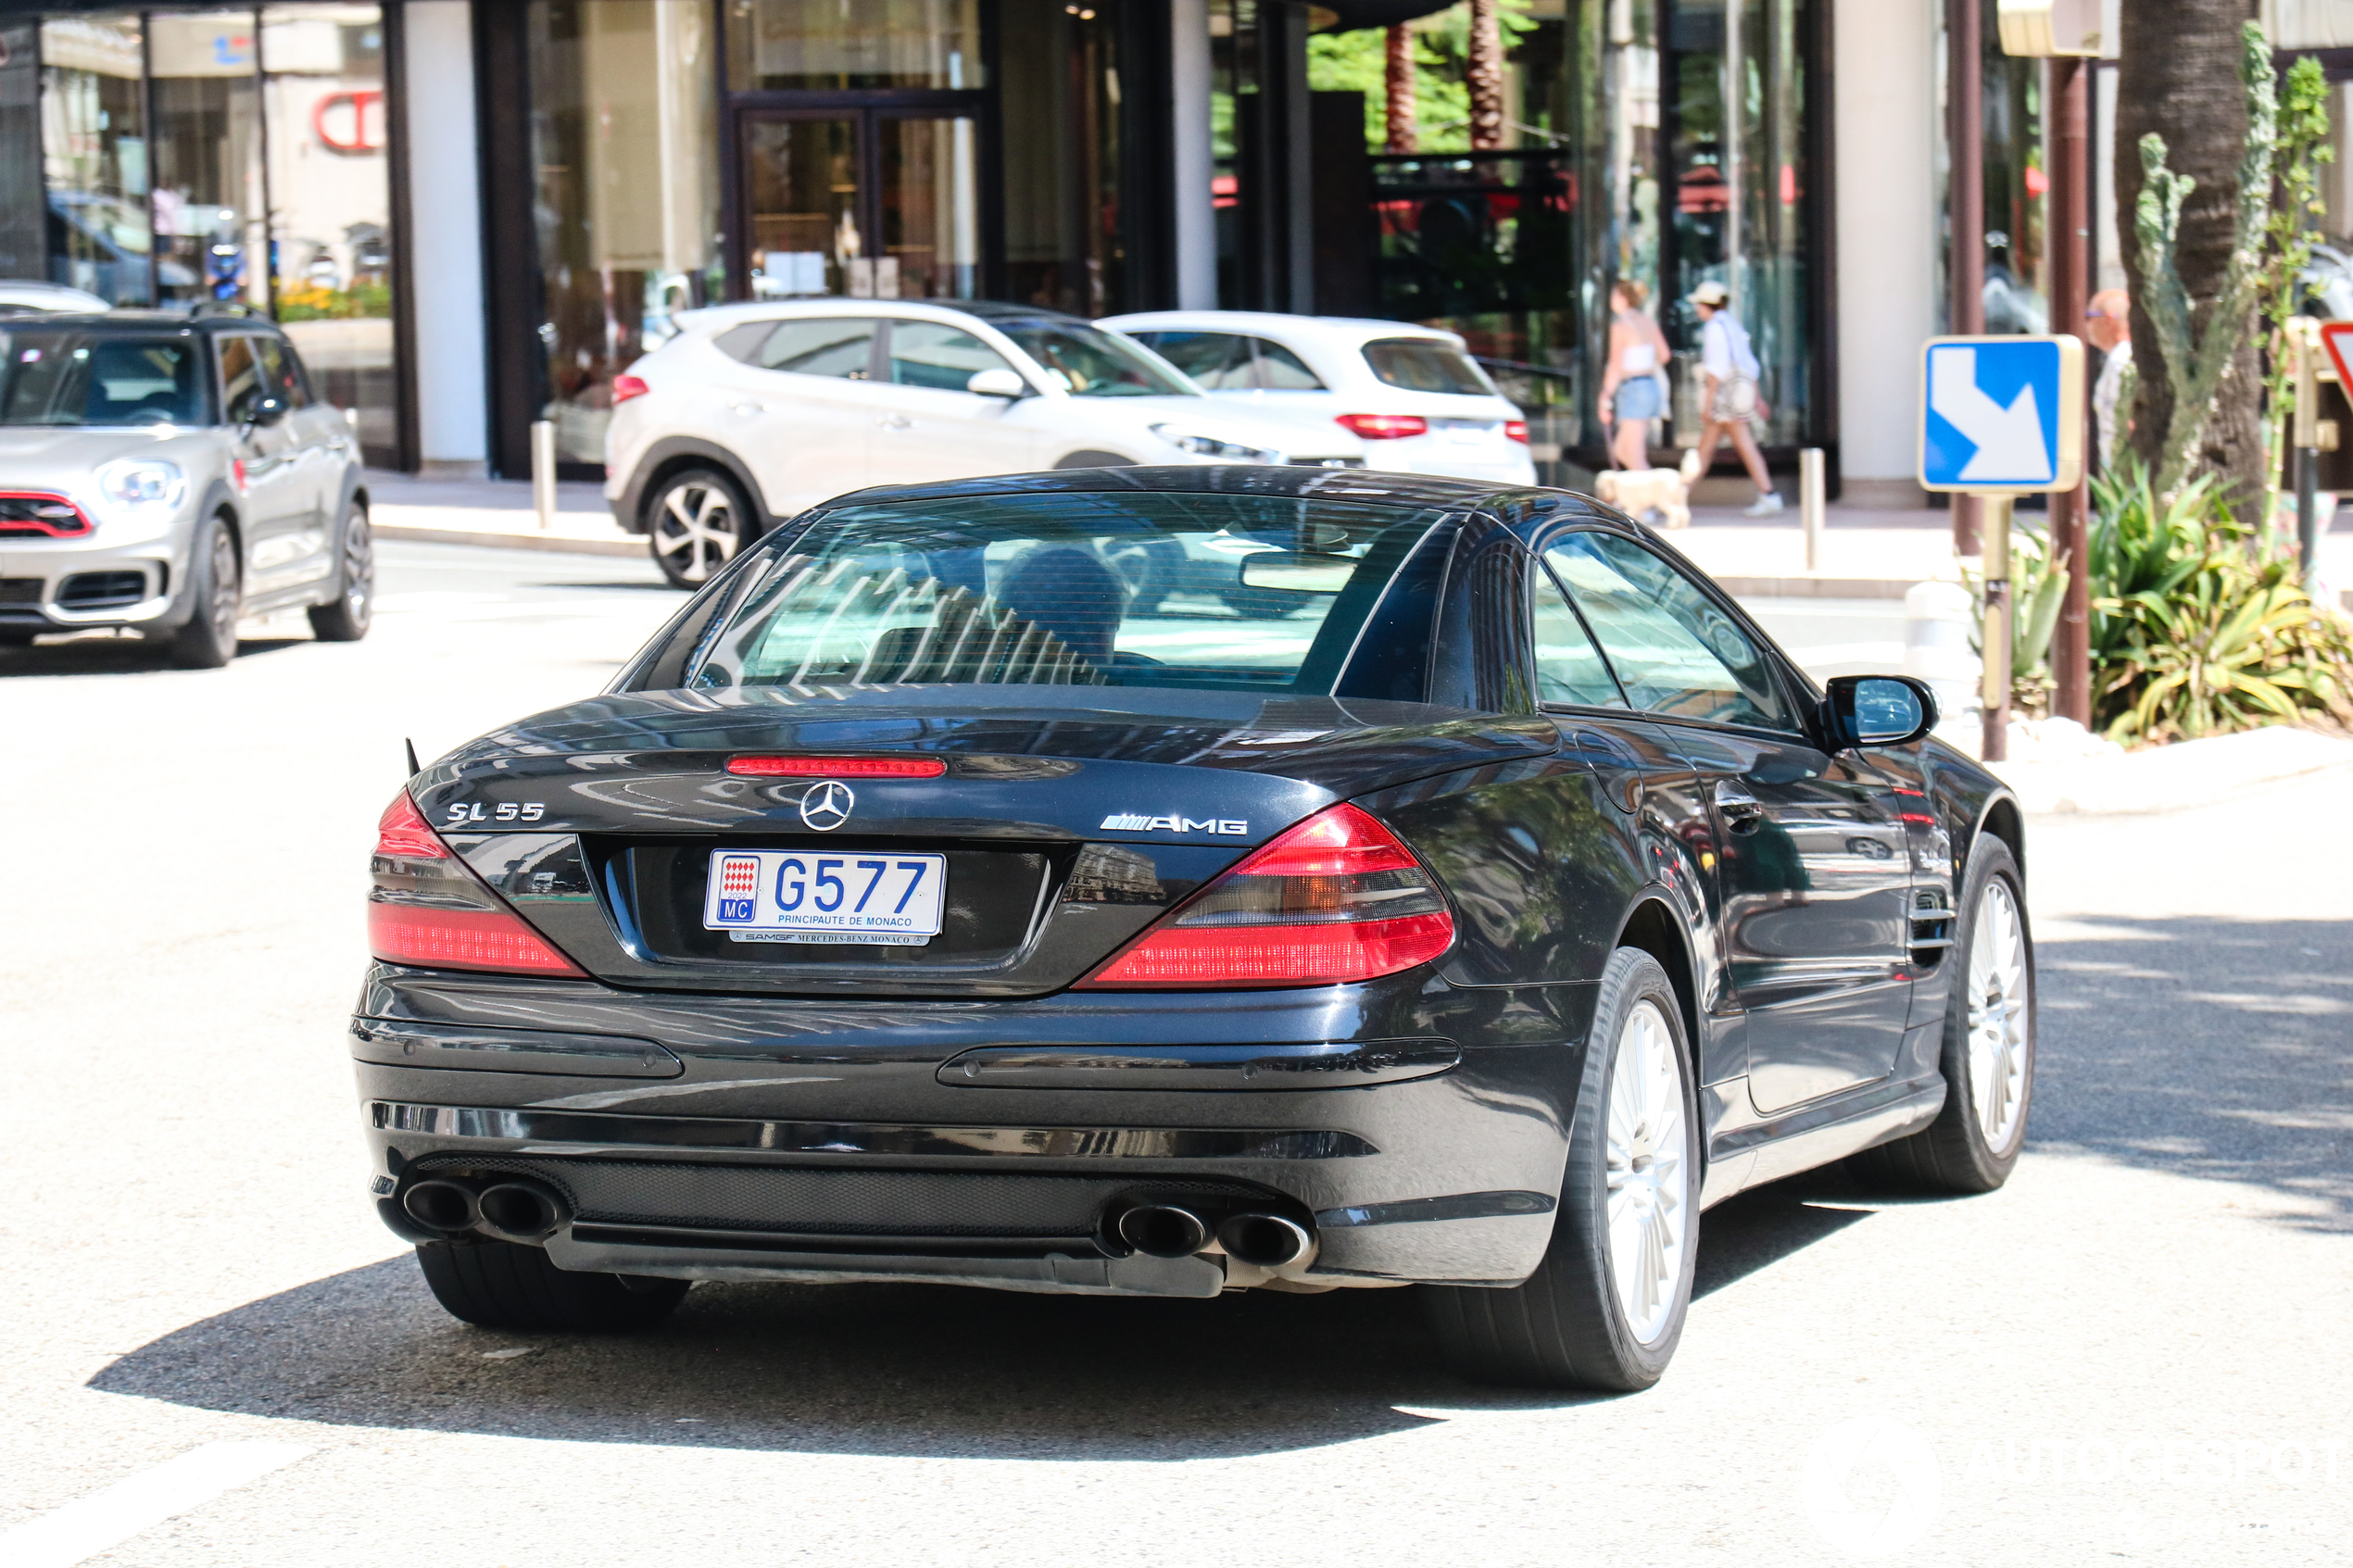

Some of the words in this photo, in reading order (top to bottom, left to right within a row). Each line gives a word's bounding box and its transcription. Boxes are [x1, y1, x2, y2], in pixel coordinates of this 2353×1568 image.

[447, 802, 487, 822] SL
[495, 802, 545, 822] 55
[1145, 815, 1248, 835] AMG
[774, 858, 927, 914] G577
[724, 901, 749, 919] MC
[778, 914, 845, 925] PRINCIPAUTE
[849, 916, 862, 925] DE
[866, 917, 912, 927] MONACO
[797, 934, 869, 943] MERCEDES-BENZ
[871, 935, 910, 944] MONACO
